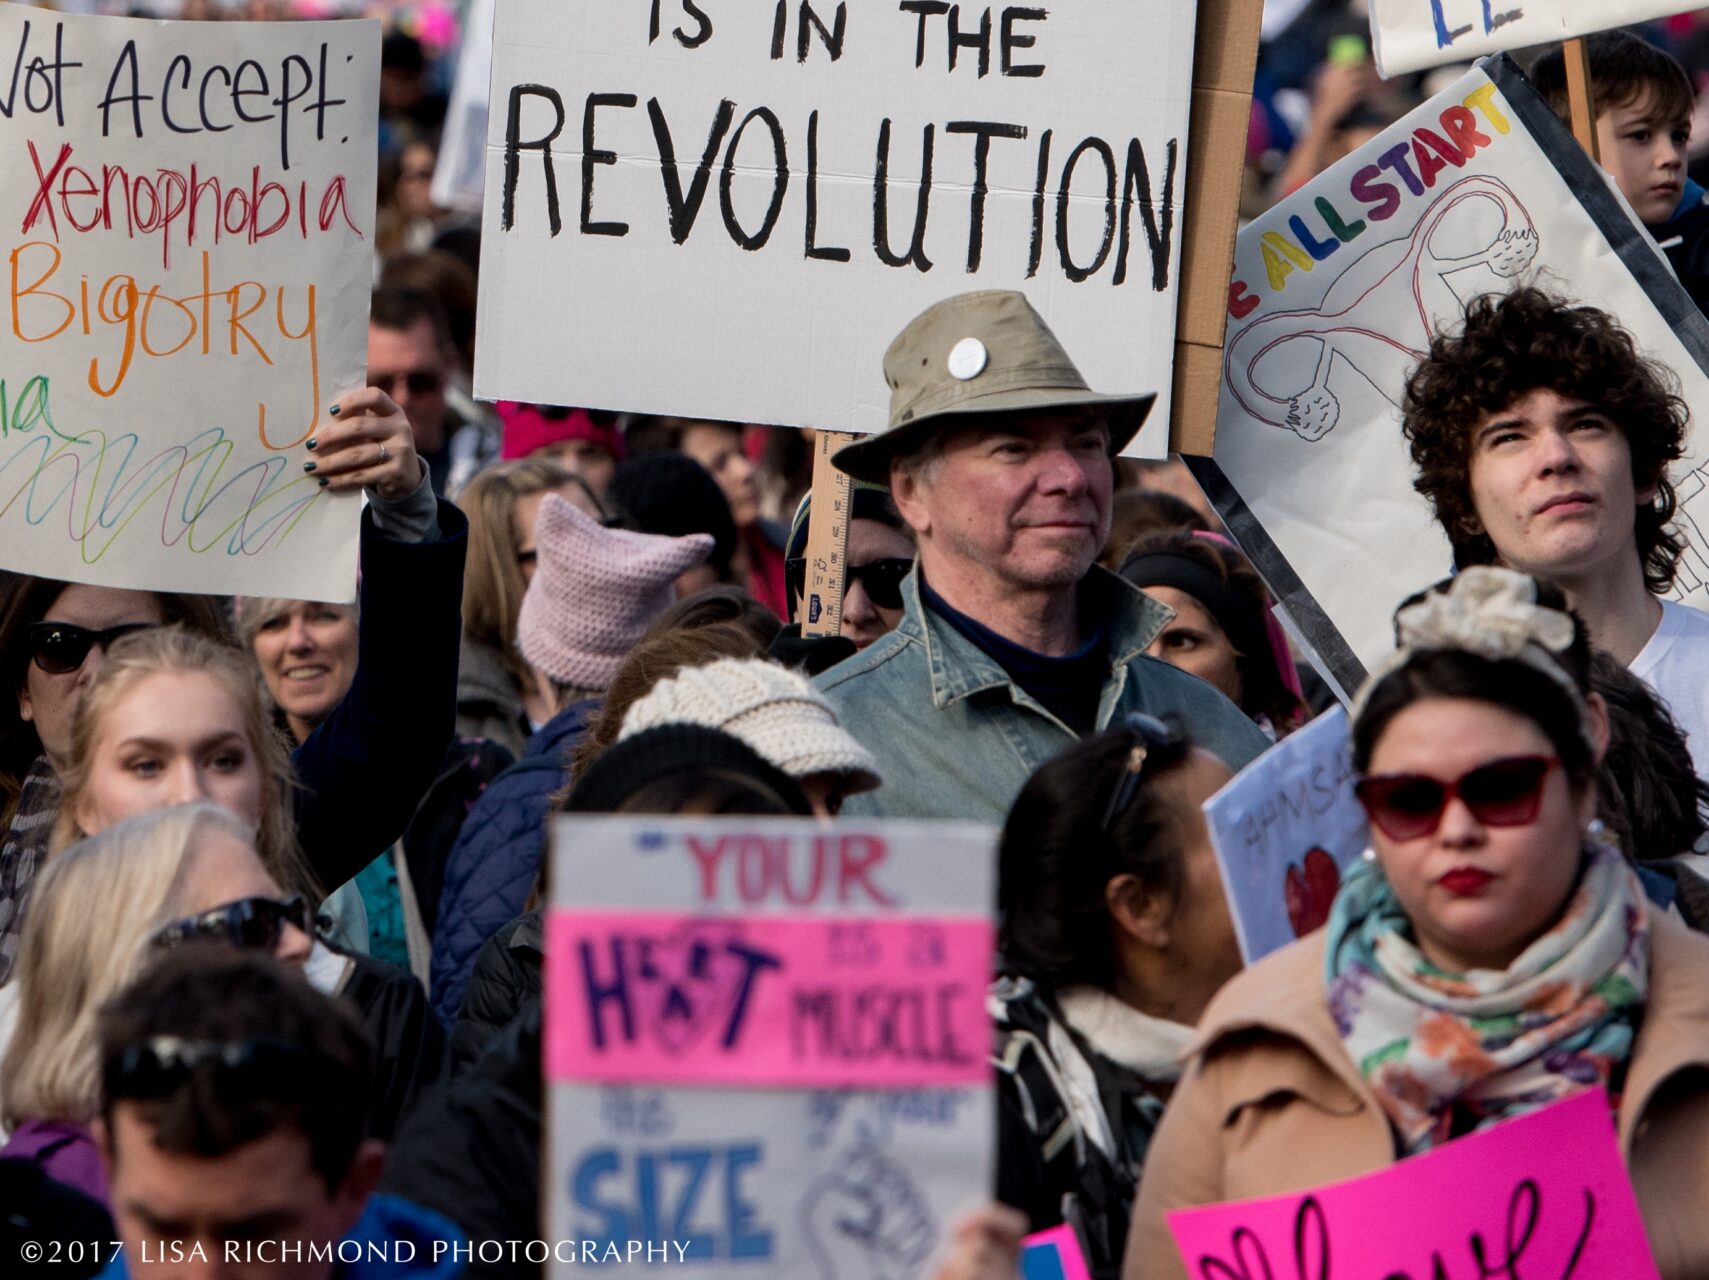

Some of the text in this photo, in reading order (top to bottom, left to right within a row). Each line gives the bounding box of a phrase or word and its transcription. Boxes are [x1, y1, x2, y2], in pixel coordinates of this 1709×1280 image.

[899, 0, 1050, 80] THE
[21, 138, 365, 271] Xenophobia
[501, 82, 1178, 292] REVOLUTION
[831, 525, 841, 538] 29
[833, 499, 842, 512] 28
[825, 604, 835, 616] 32
[828, 577, 837, 590] 31
[686, 833, 898, 905] YOUR
[569, 1139, 775, 1263] SIZE
